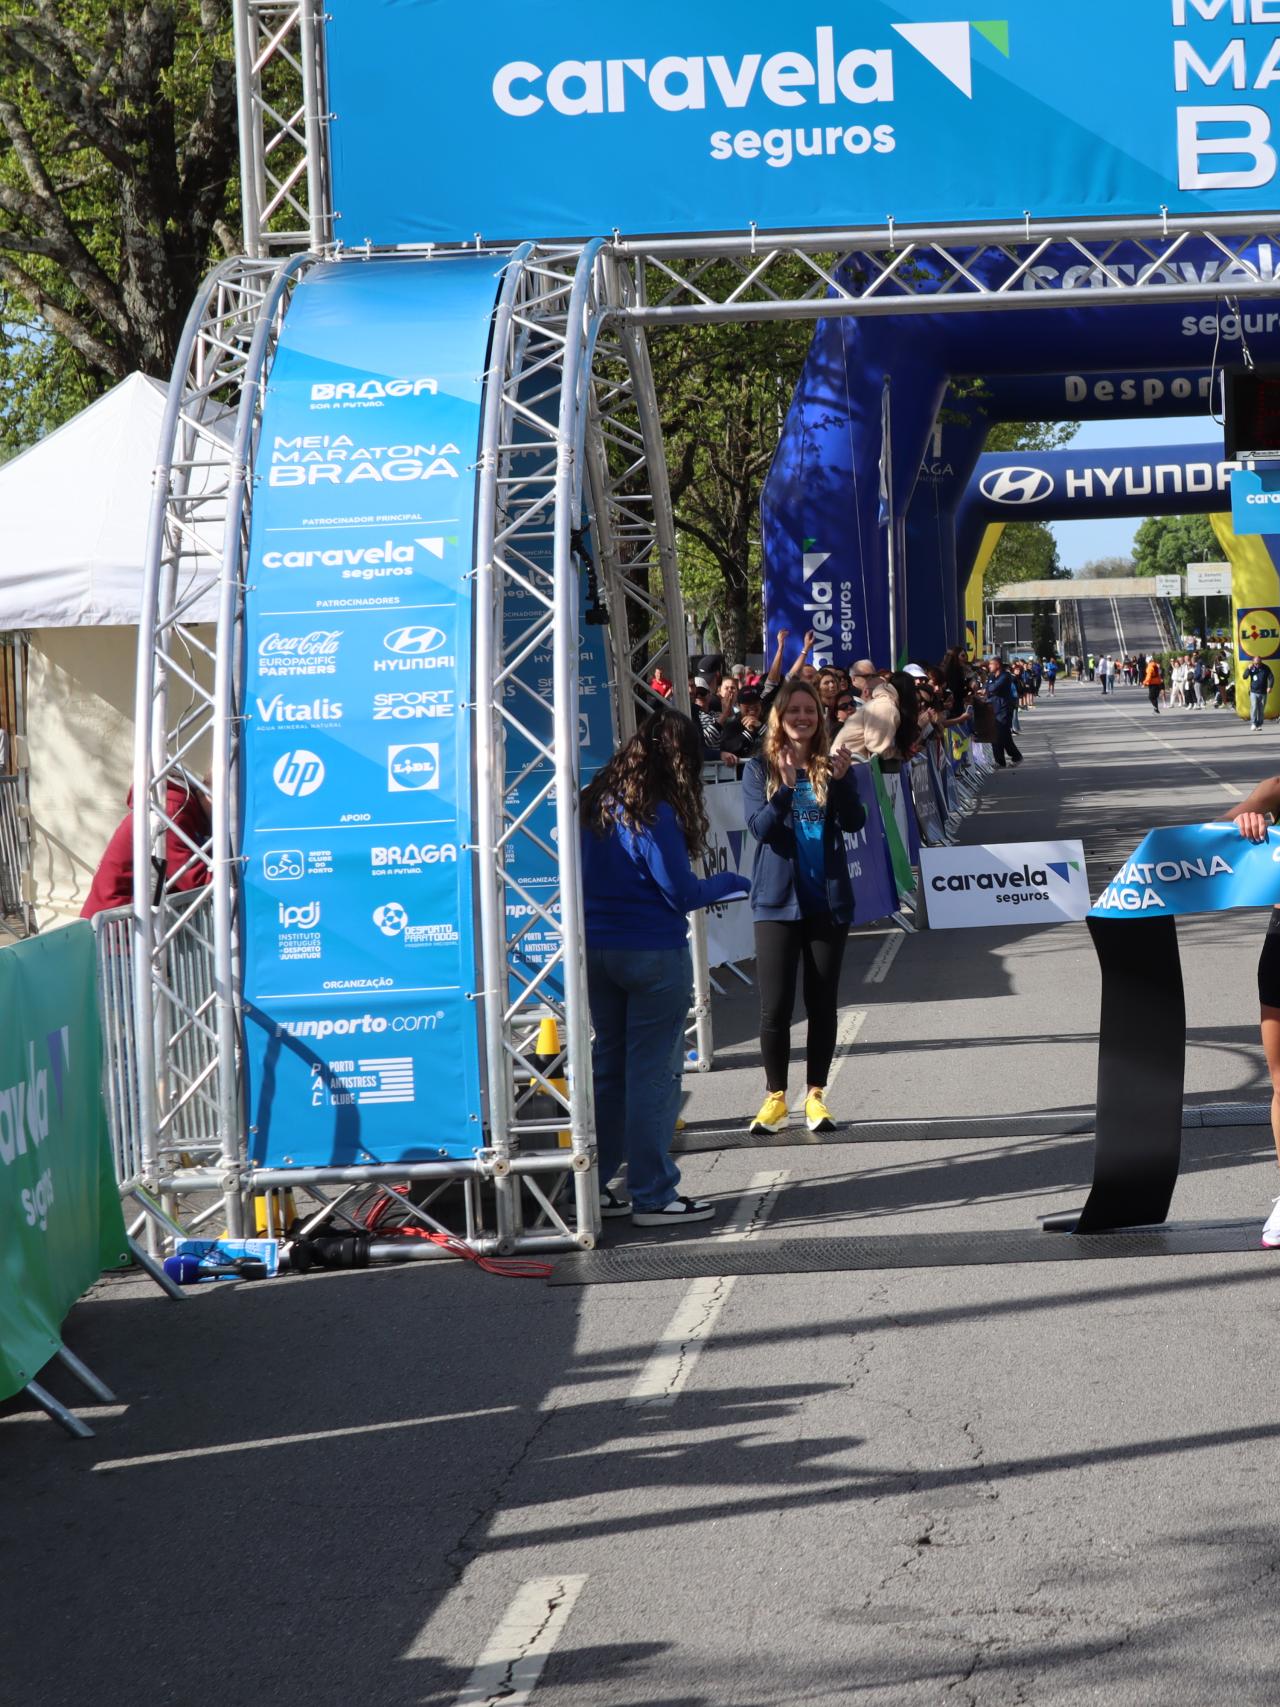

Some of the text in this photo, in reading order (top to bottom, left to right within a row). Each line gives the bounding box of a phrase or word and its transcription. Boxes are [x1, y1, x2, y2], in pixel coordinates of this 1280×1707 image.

[492, 26, 895, 117] caravela
[709, 123, 896, 168] seguros
[310, 378, 438, 401] BRAGA
[274, 434, 354, 449] MEIA
[271, 442, 461, 464] MARATONA
[268, 457, 459, 487] BRAGA
[302, 512, 422, 525] PATROCINADOR PRINCIPAL
[262, 540, 415, 569] caravela
[342, 565, 413, 580] seguros
[316, 596, 400, 608] PATROCINADORES
[840, 581, 856, 651] seguros
[258, 655, 336, 667] EUROPACIFIC
[374, 655, 455, 672] HYUNDAI
[258, 664, 336, 677] PARTNERS
[373, 690, 454, 706] SPORT
[256, 693, 343, 722] Vitalis
[372, 703, 454, 720] ZONE
[276, 750, 323, 797] hp
[340, 813, 371, 823] APOIO
[370, 843, 457, 867] BRAGA
[931, 864, 1048, 892] caravela
[996, 889, 1049, 905] seguros
[278, 901, 321, 929] ipdj
[278, 932, 321, 941] INSTITUTO
[323, 978, 394, 990] ORGANIZAÇÃO
[329, 1060, 354, 1073] PORTO
[330, 1076, 377, 1089] ANTISTRESS
[331, 1093, 355, 1105] CLUBE
